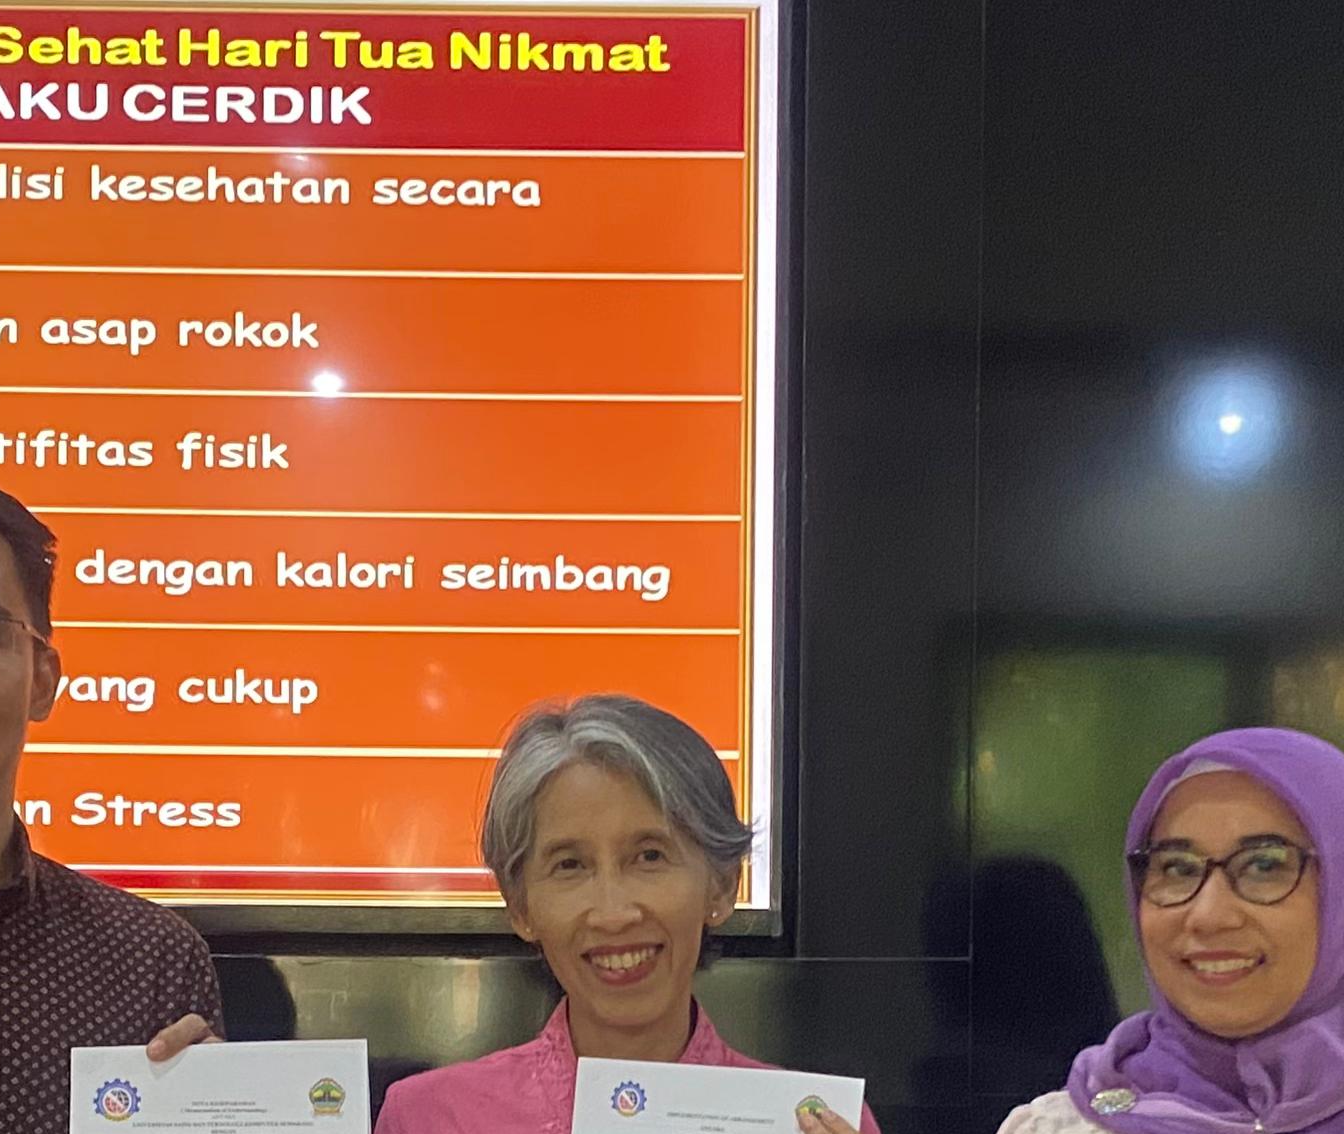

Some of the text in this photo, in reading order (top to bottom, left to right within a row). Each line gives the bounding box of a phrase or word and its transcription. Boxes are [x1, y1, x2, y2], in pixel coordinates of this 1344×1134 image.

[179, 29, 309, 69] Hari
[320, 31, 434, 70] Tua
[450, 33, 671, 73] Nikmat
[123, 85, 373, 126] CERDIK
[91, 164, 351, 206] kesehatan
[373, 177, 542, 208] secara
[40, 318, 158, 356] asap
[179, 312, 320, 350] rokok
[176, 431, 291, 472] fisik
[75, 548, 672, 603] dengan kalori seimbang
[178, 669, 319, 715] cukup
[71, 792, 243, 829] Stress
